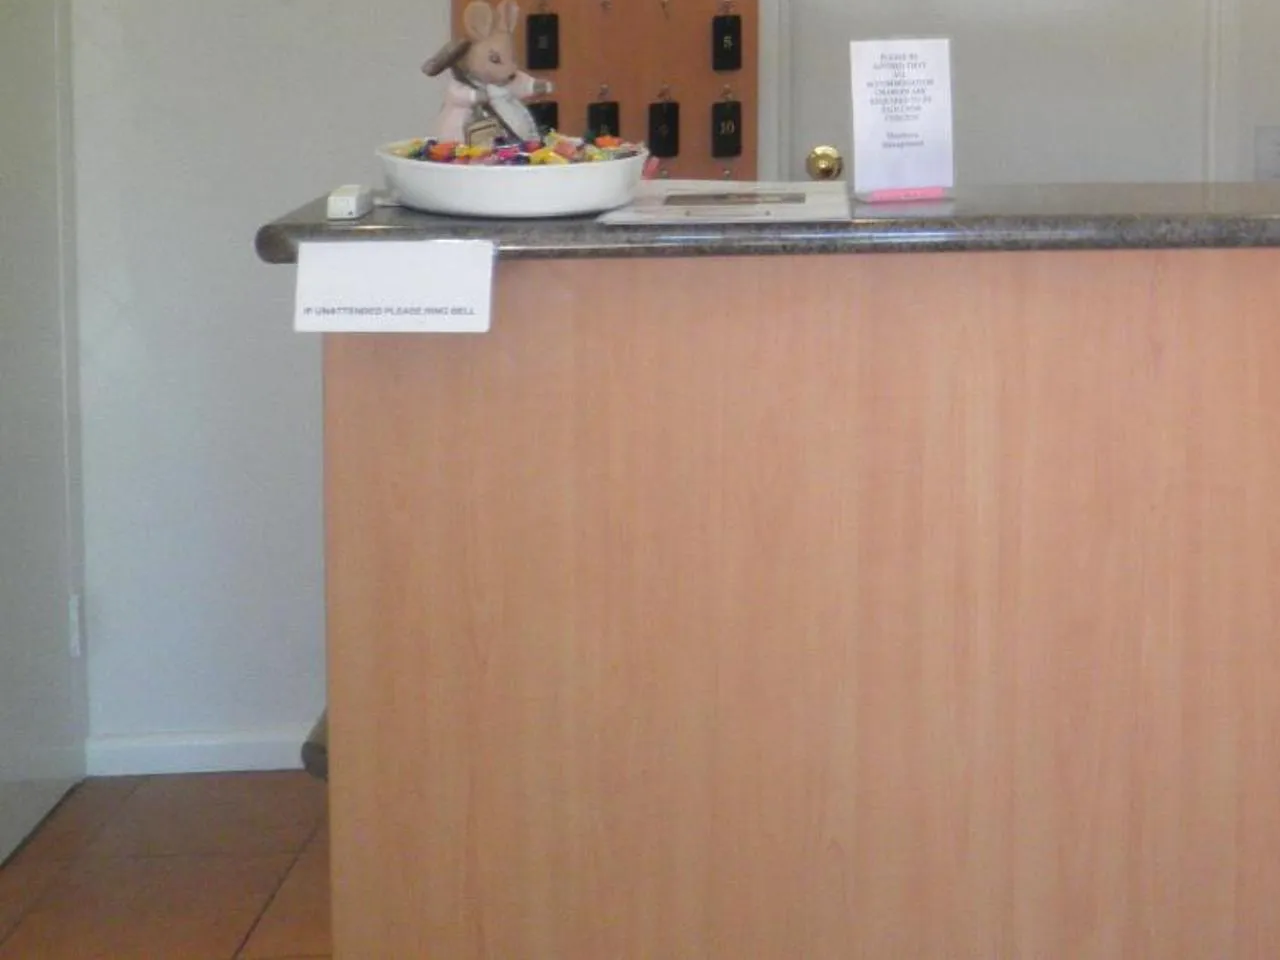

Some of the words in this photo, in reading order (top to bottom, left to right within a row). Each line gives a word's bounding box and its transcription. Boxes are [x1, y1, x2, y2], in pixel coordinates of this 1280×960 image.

[315, 307, 383, 315] UNATTENDED
[384, 307, 421, 315] PLEASE
[450, 307, 476, 315] BELL
